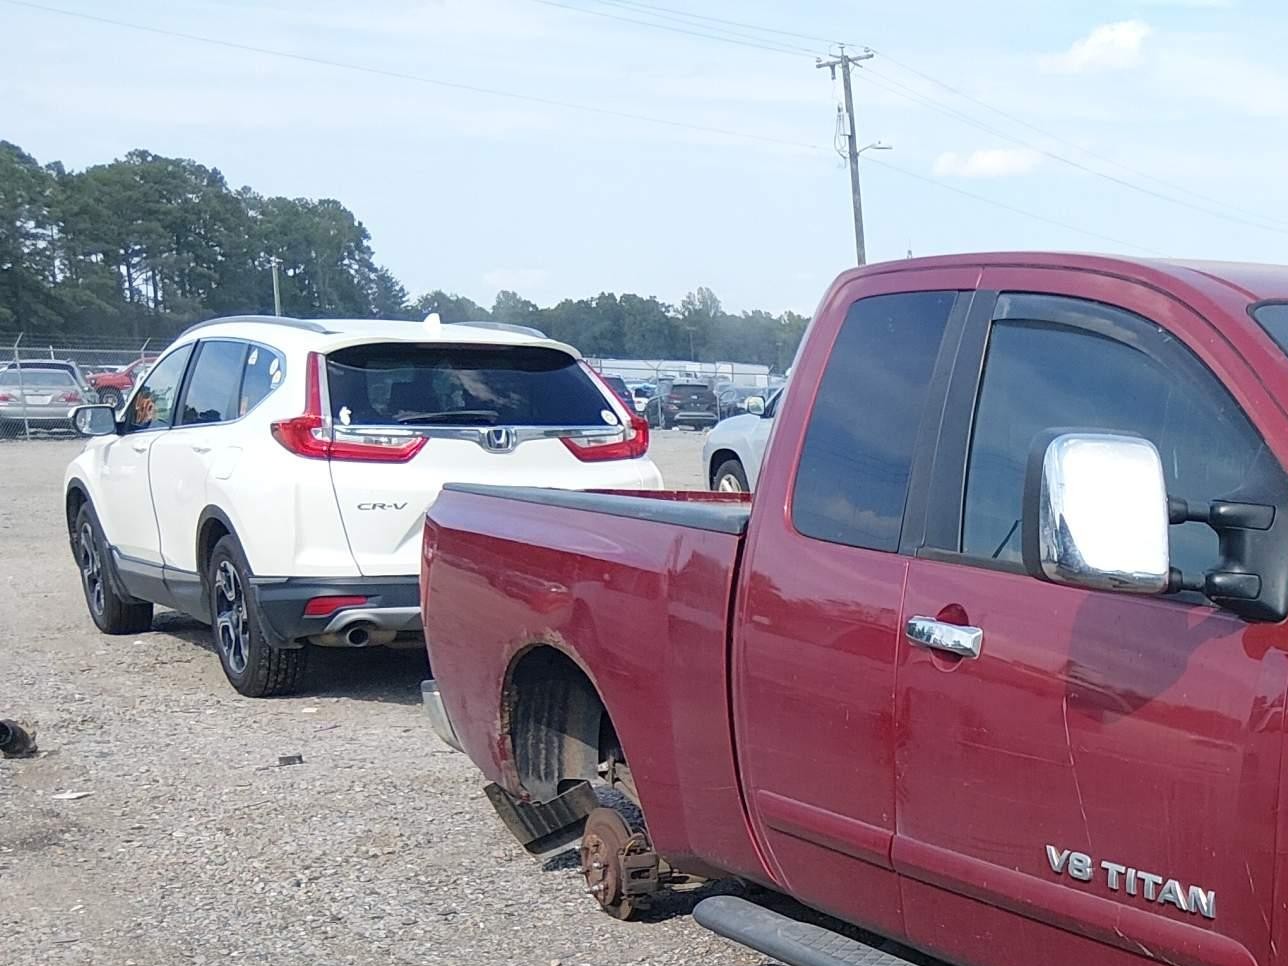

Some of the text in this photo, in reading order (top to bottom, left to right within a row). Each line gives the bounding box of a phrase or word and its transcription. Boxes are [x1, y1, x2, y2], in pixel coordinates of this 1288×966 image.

[357, 502, 408, 511] CR-V
[1045, 844, 1216, 919] V8 TITAN
